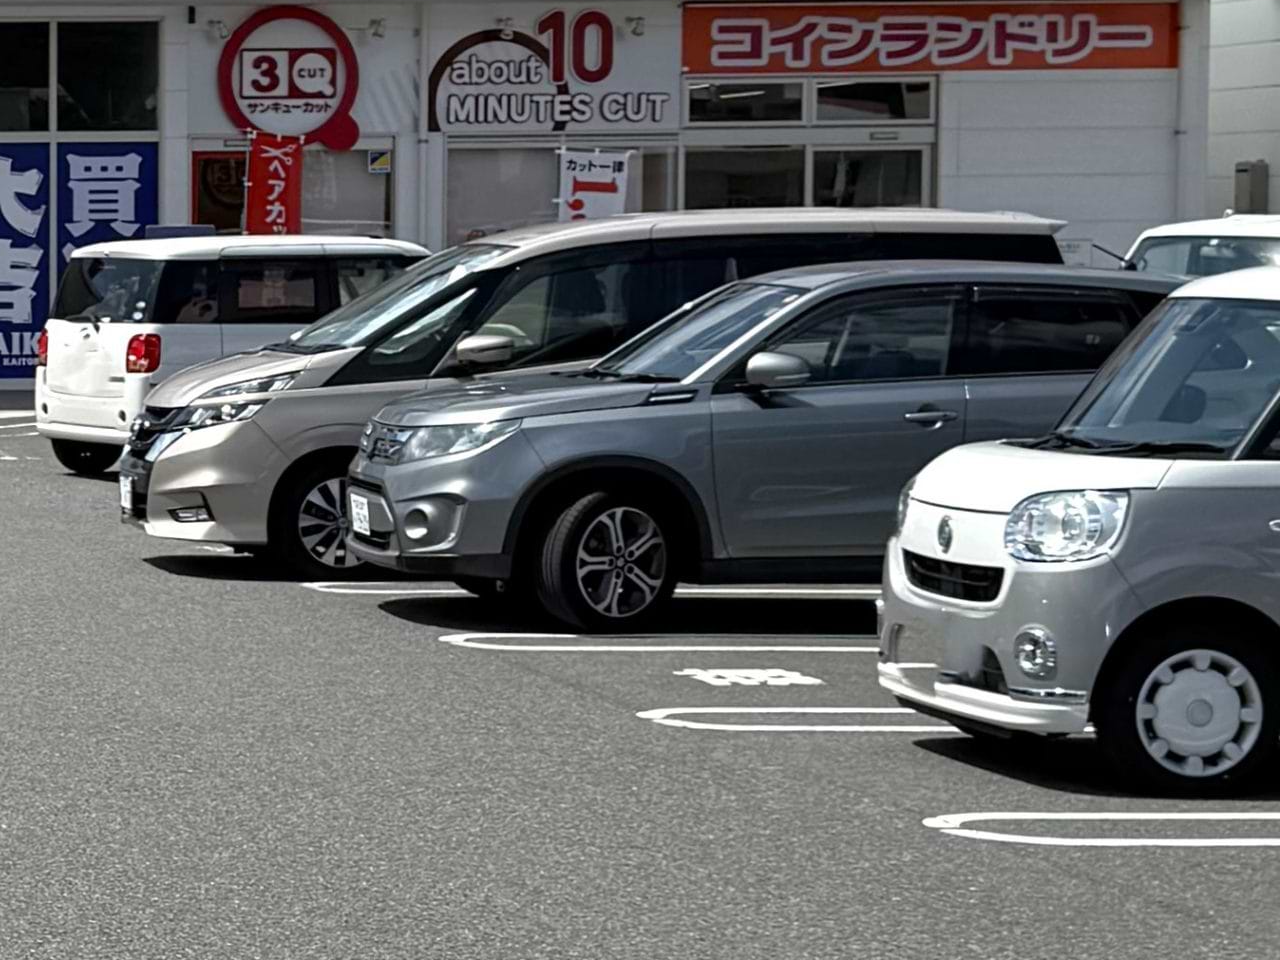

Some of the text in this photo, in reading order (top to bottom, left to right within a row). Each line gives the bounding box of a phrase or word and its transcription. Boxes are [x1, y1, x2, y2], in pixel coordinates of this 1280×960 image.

[448, 7, 615, 86] about 10
[710, 13, 1153, 68] コインランドリー
[297, 68, 326, 78] CUT
[247, 102, 332, 114] サンキューカット
[446, 91, 671, 124] MINUTES CUT
